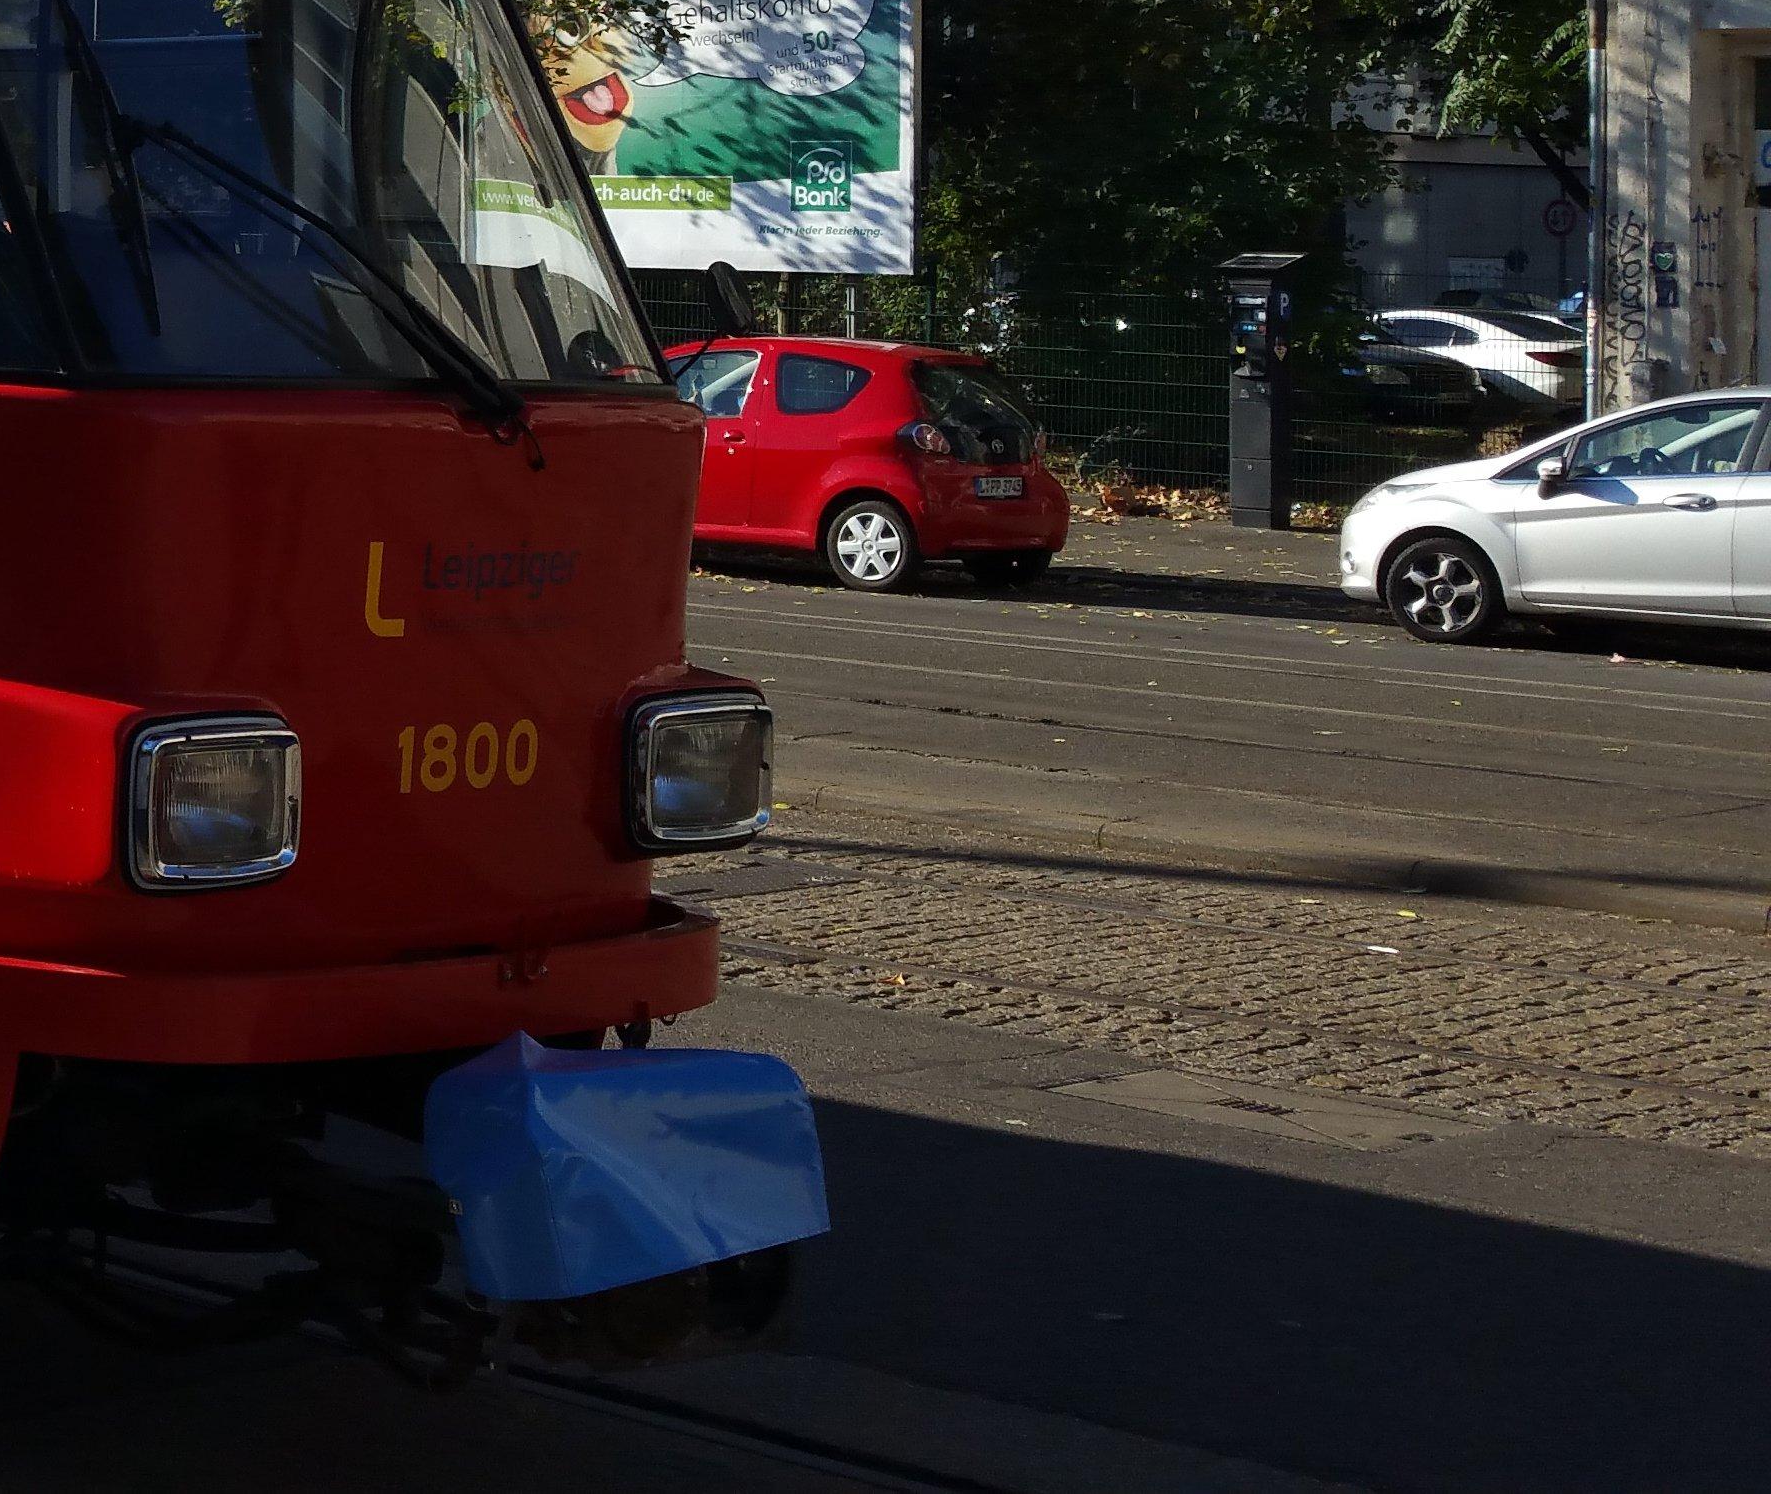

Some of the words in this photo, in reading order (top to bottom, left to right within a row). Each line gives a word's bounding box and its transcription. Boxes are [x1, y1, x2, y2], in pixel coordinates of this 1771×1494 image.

[776, 44, 800, 58] und
[790, 73, 832, 89] sichern
[795, 186, 847, 207] Bank
[796, 224, 823, 237] jeder
[826, 226, 884, 238] Beziehung.
[422, 540, 581, 601] Leipziger
[364, 541, 405, 637] L
[398, 718, 539, 794] 1800
